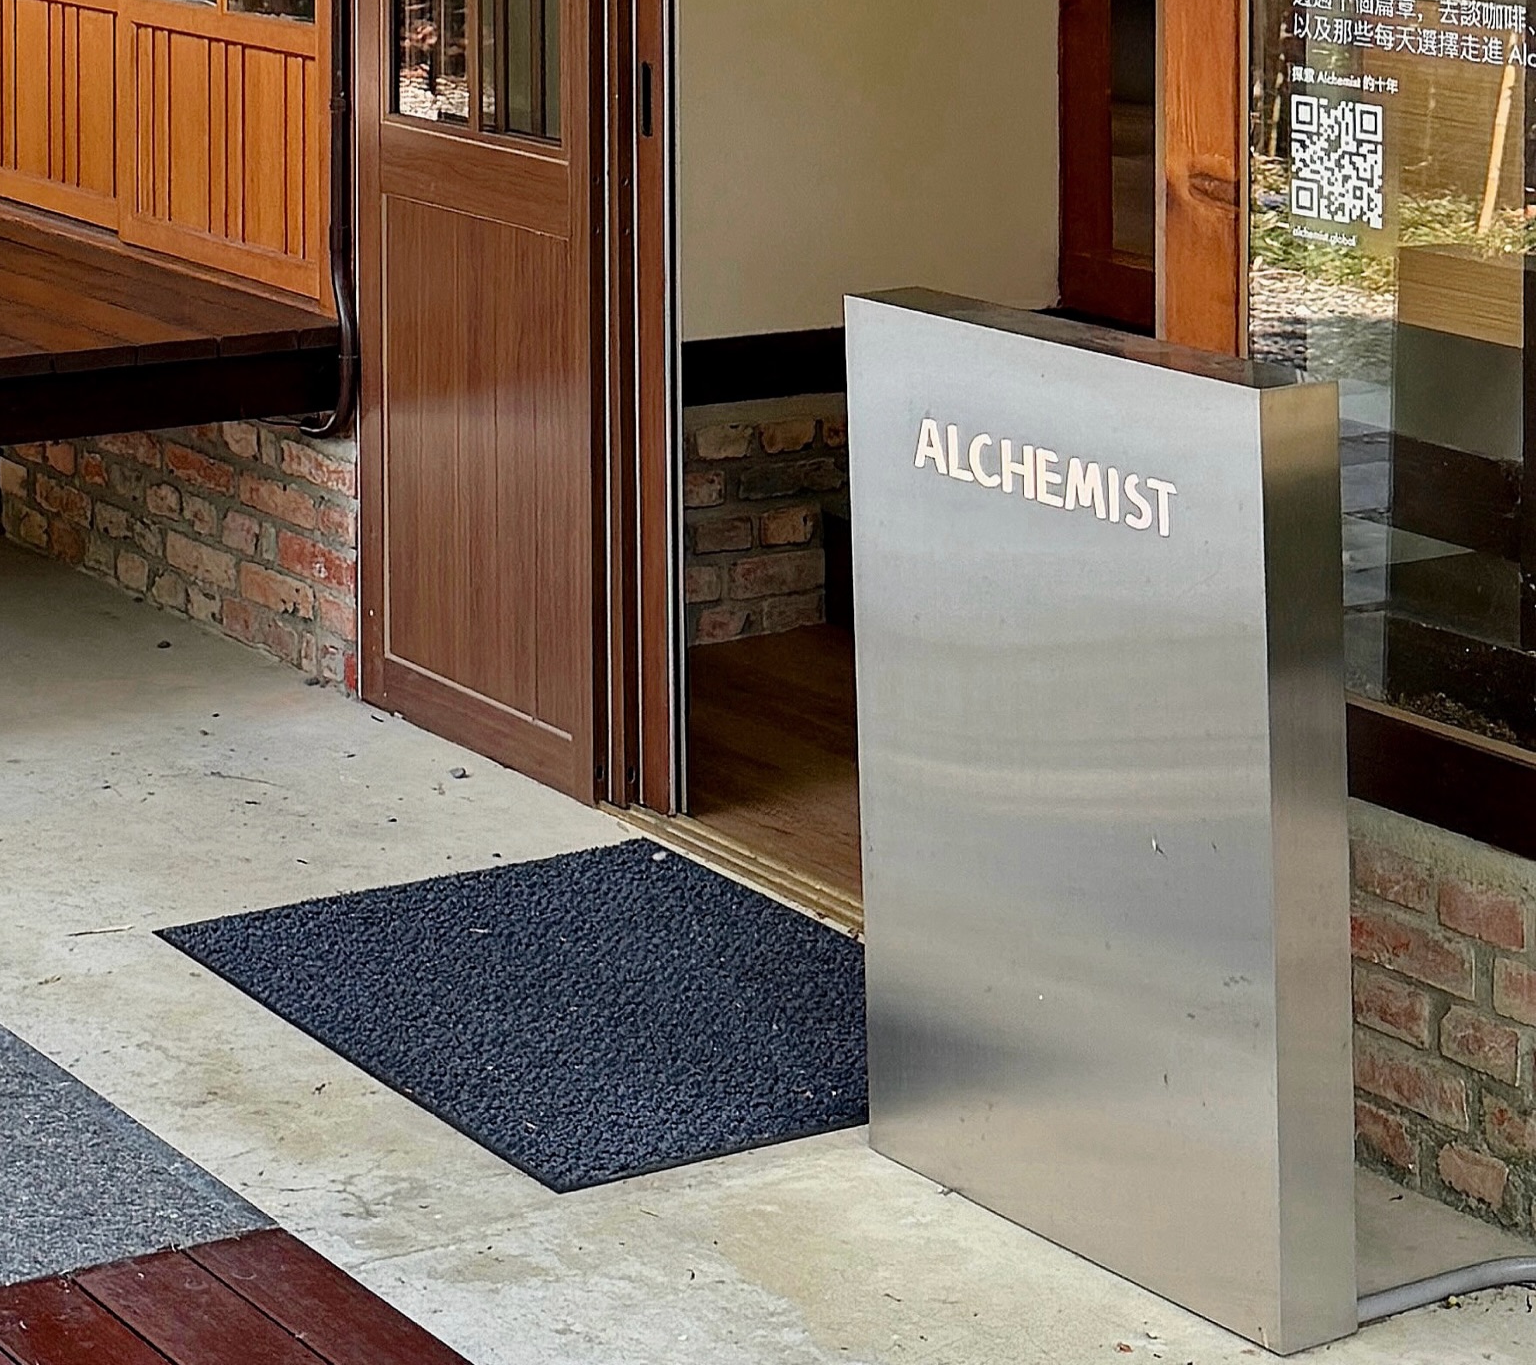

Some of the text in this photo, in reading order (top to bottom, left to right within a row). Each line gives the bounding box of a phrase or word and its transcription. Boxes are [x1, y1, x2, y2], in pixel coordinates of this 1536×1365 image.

[1293, 12, 1504, 65] 以及那些每天選擇走進
[1362, 74, 1399, 95] 的十年
[913, 417, 1178, 538] ALCHEMIST
